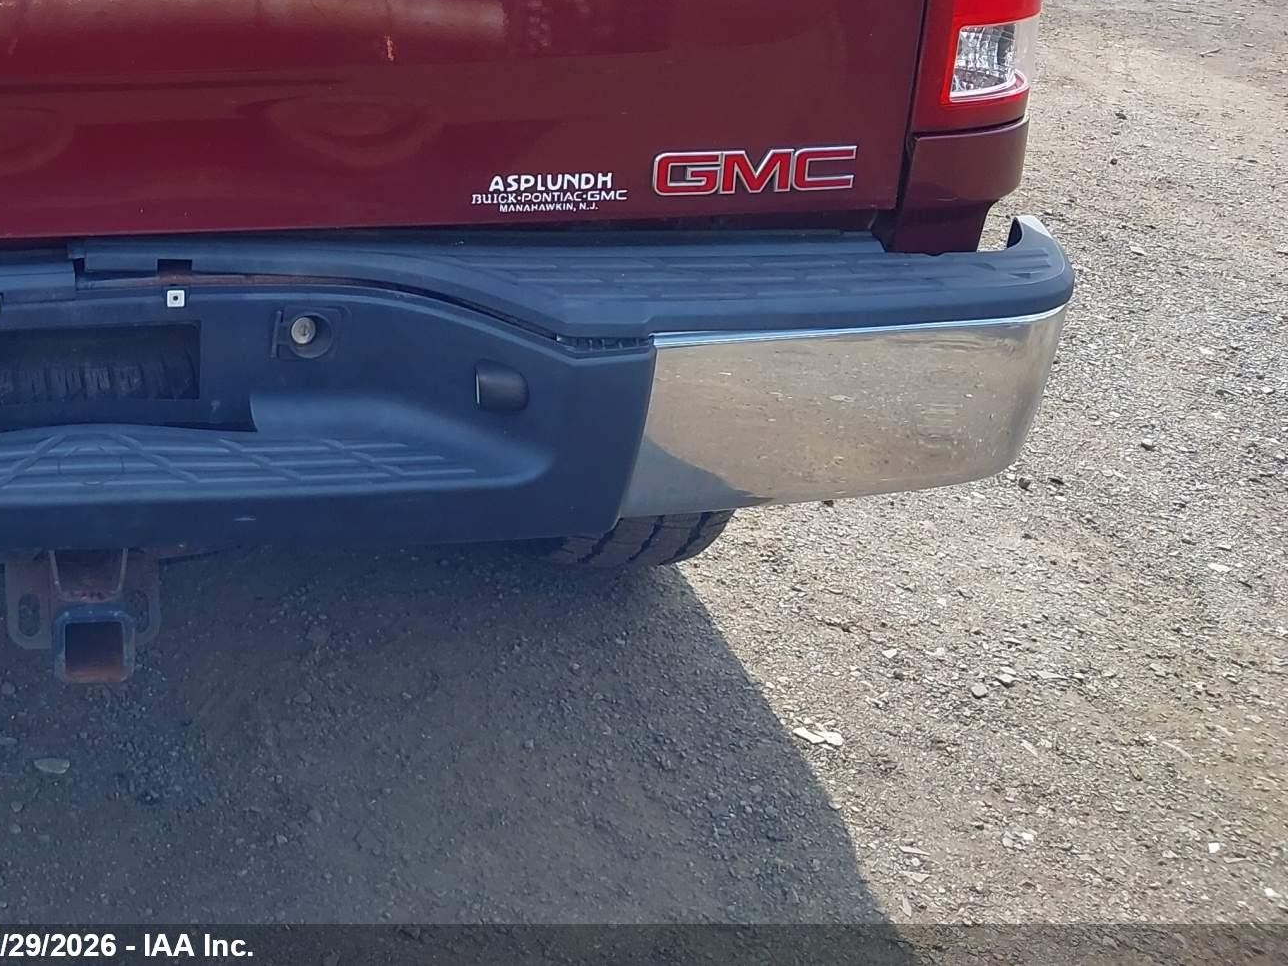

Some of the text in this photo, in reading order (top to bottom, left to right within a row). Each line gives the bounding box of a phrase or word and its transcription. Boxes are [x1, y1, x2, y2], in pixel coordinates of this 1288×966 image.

[652, 145, 858, 196] GMC
[488, 172, 613, 192] ASPLUNDH
[499, 201, 599, 213] MANAHAWKIN, N.J.
